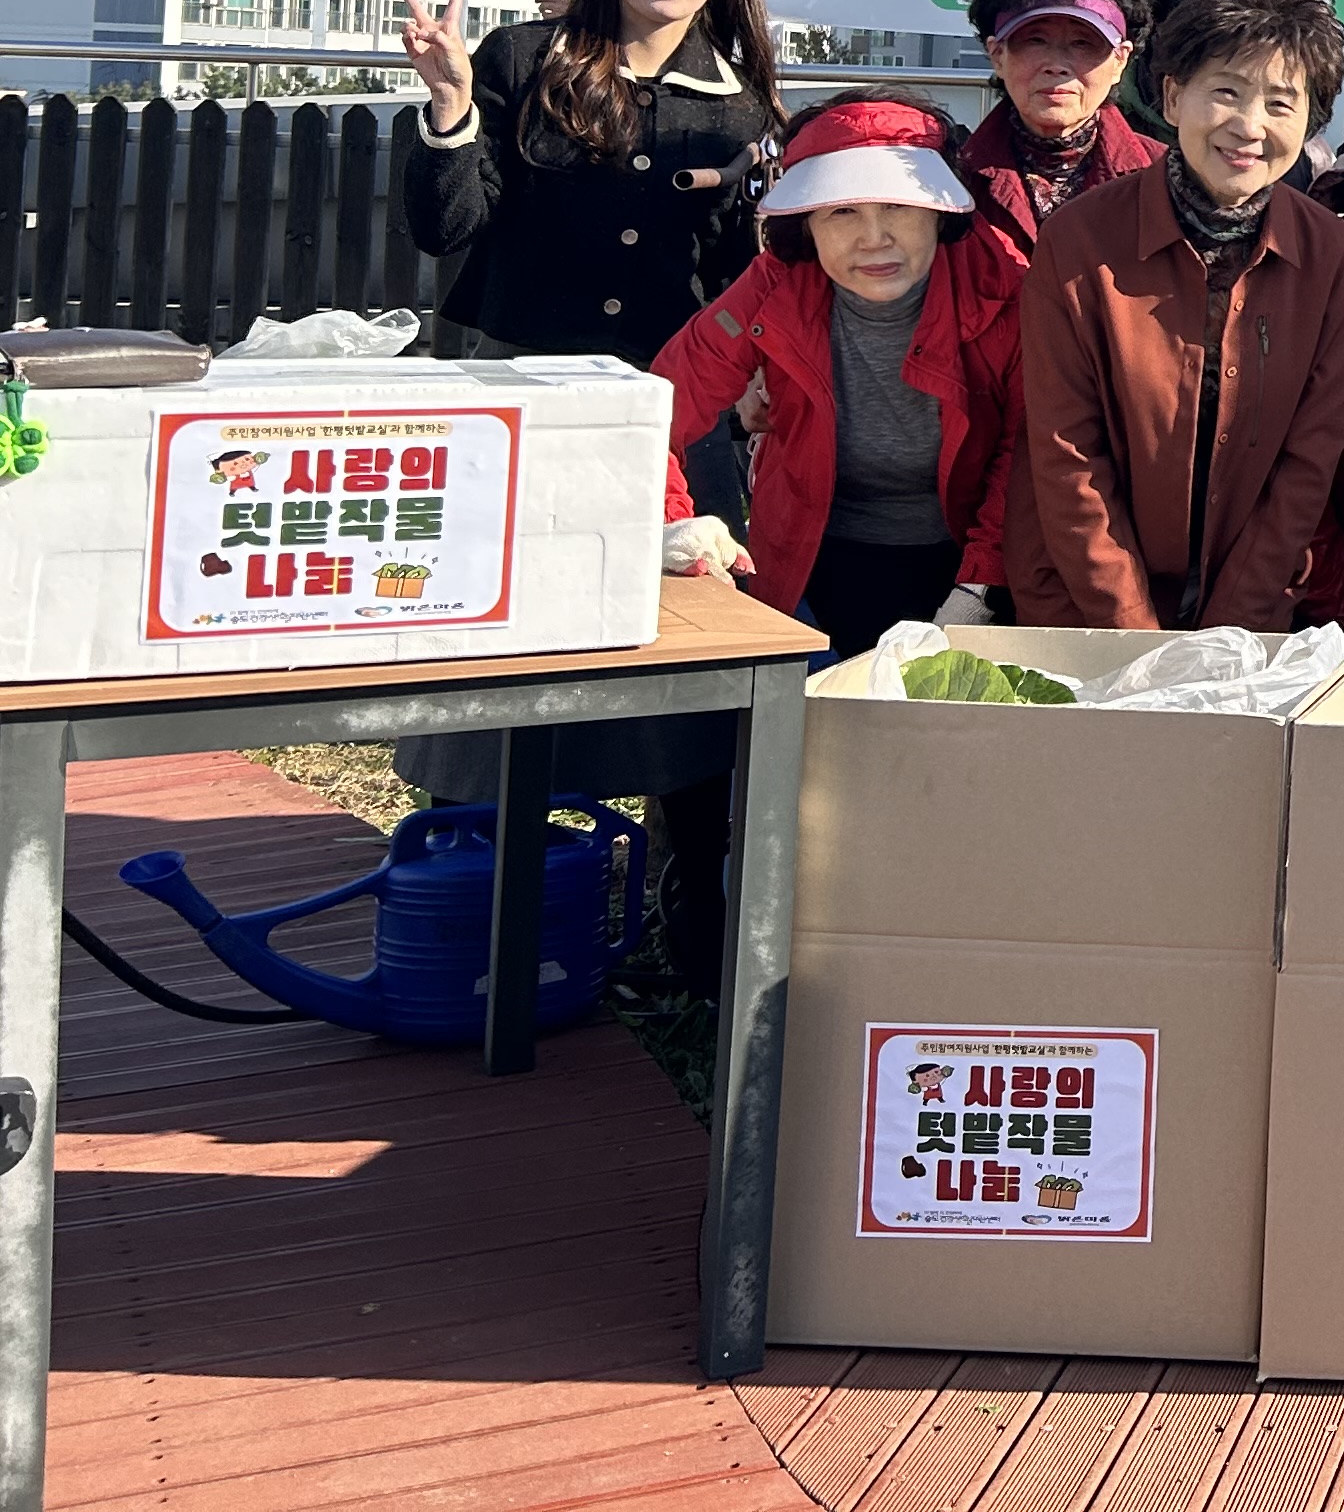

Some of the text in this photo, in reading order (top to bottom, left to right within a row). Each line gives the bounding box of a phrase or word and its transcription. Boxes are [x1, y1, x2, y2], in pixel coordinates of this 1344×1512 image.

[226, 424, 316, 439] 주민참여지원사업
[404, 423, 447, 435] 함께하는
[283, 446, 449, 494] 사랑의
[220, 496, 444, 548] 텃밭작물
[964, 1065, 1095, 1109] 사랑의
[916, 1111, 1092, 1156] 텃밭작물
